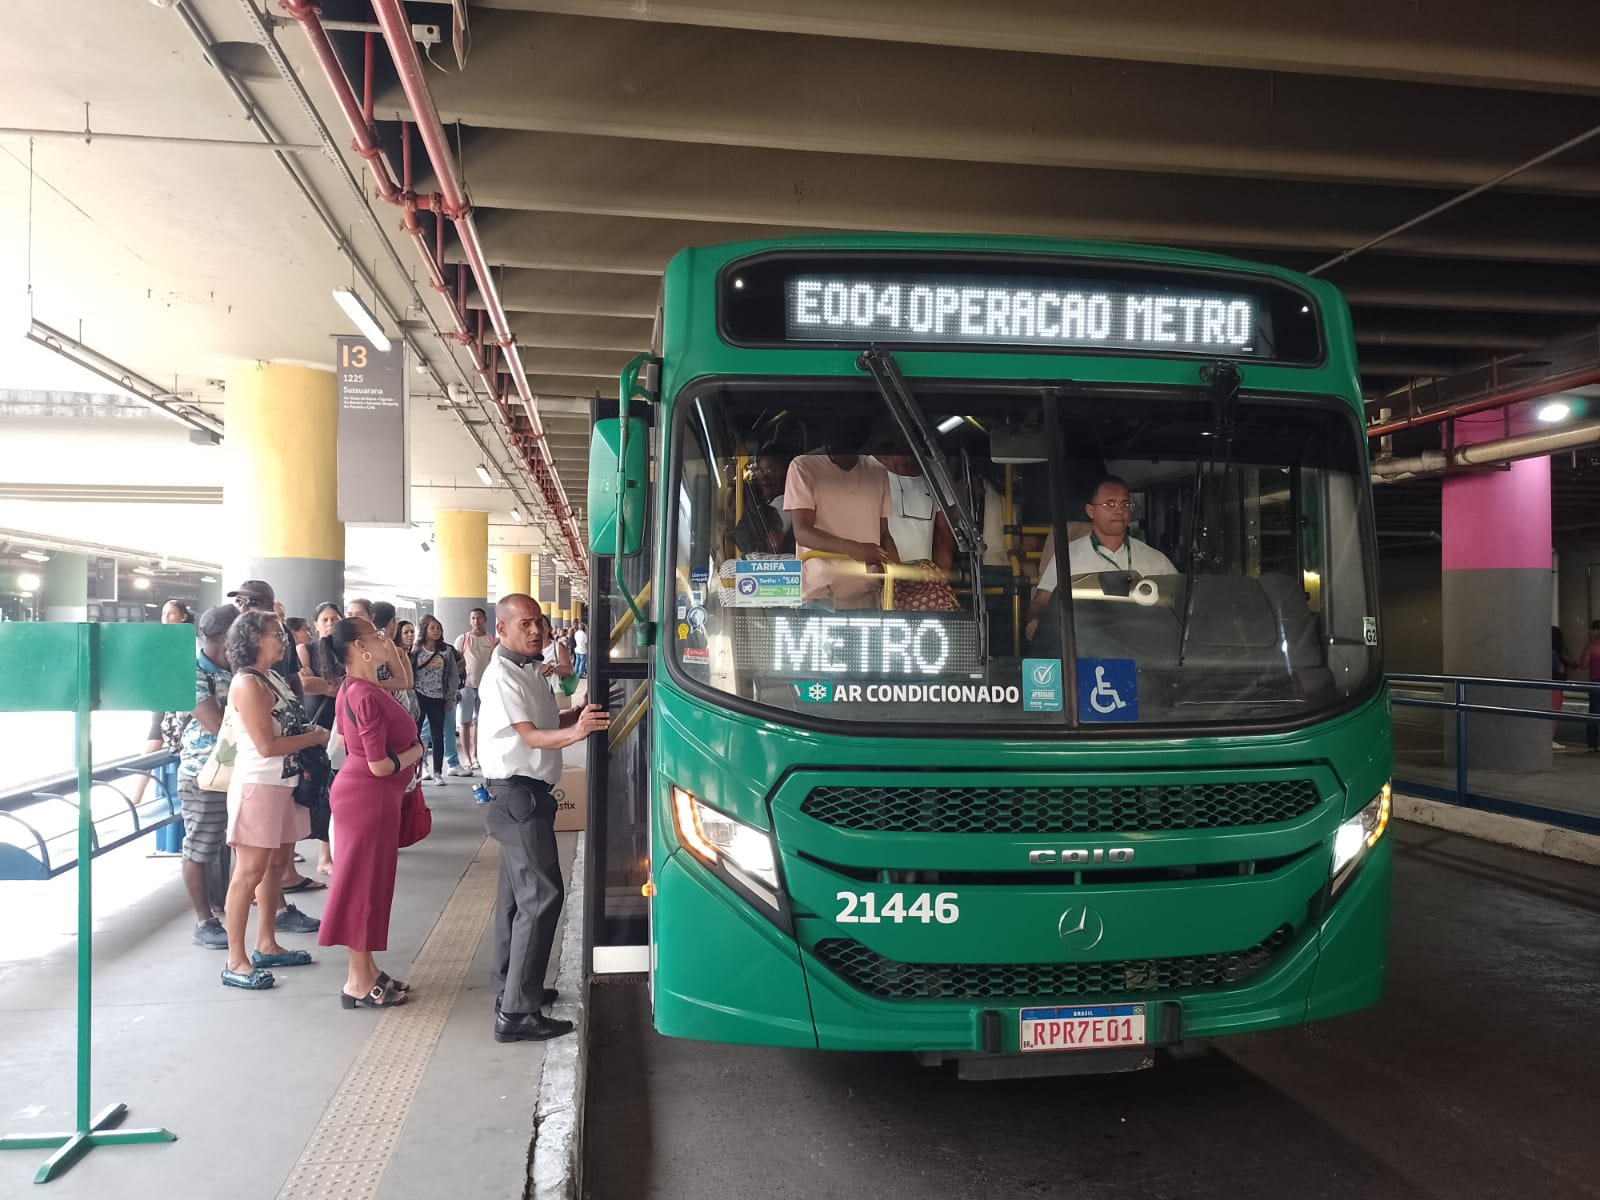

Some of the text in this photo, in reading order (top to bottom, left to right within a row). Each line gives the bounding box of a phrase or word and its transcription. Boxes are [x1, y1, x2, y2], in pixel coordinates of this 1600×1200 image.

[797, 280, 1252, 345] E004 OPERACAO METRO
[343, 374, 364, 383] 1225
[343, 386, 383, 395] Sussuarana
[750, 562, 786, 571] TARIFA
[773, 616, 950, 674] METRO
[1366, 629, 1376, 642] G2
[833, 684, 1020, 704] AR CONDICIONADO
[1029, 847, 1135, 865] CAIO
[835, 891, 960, 924] 21446
[1033, 1018, 1133, 1046] RPR7E01
